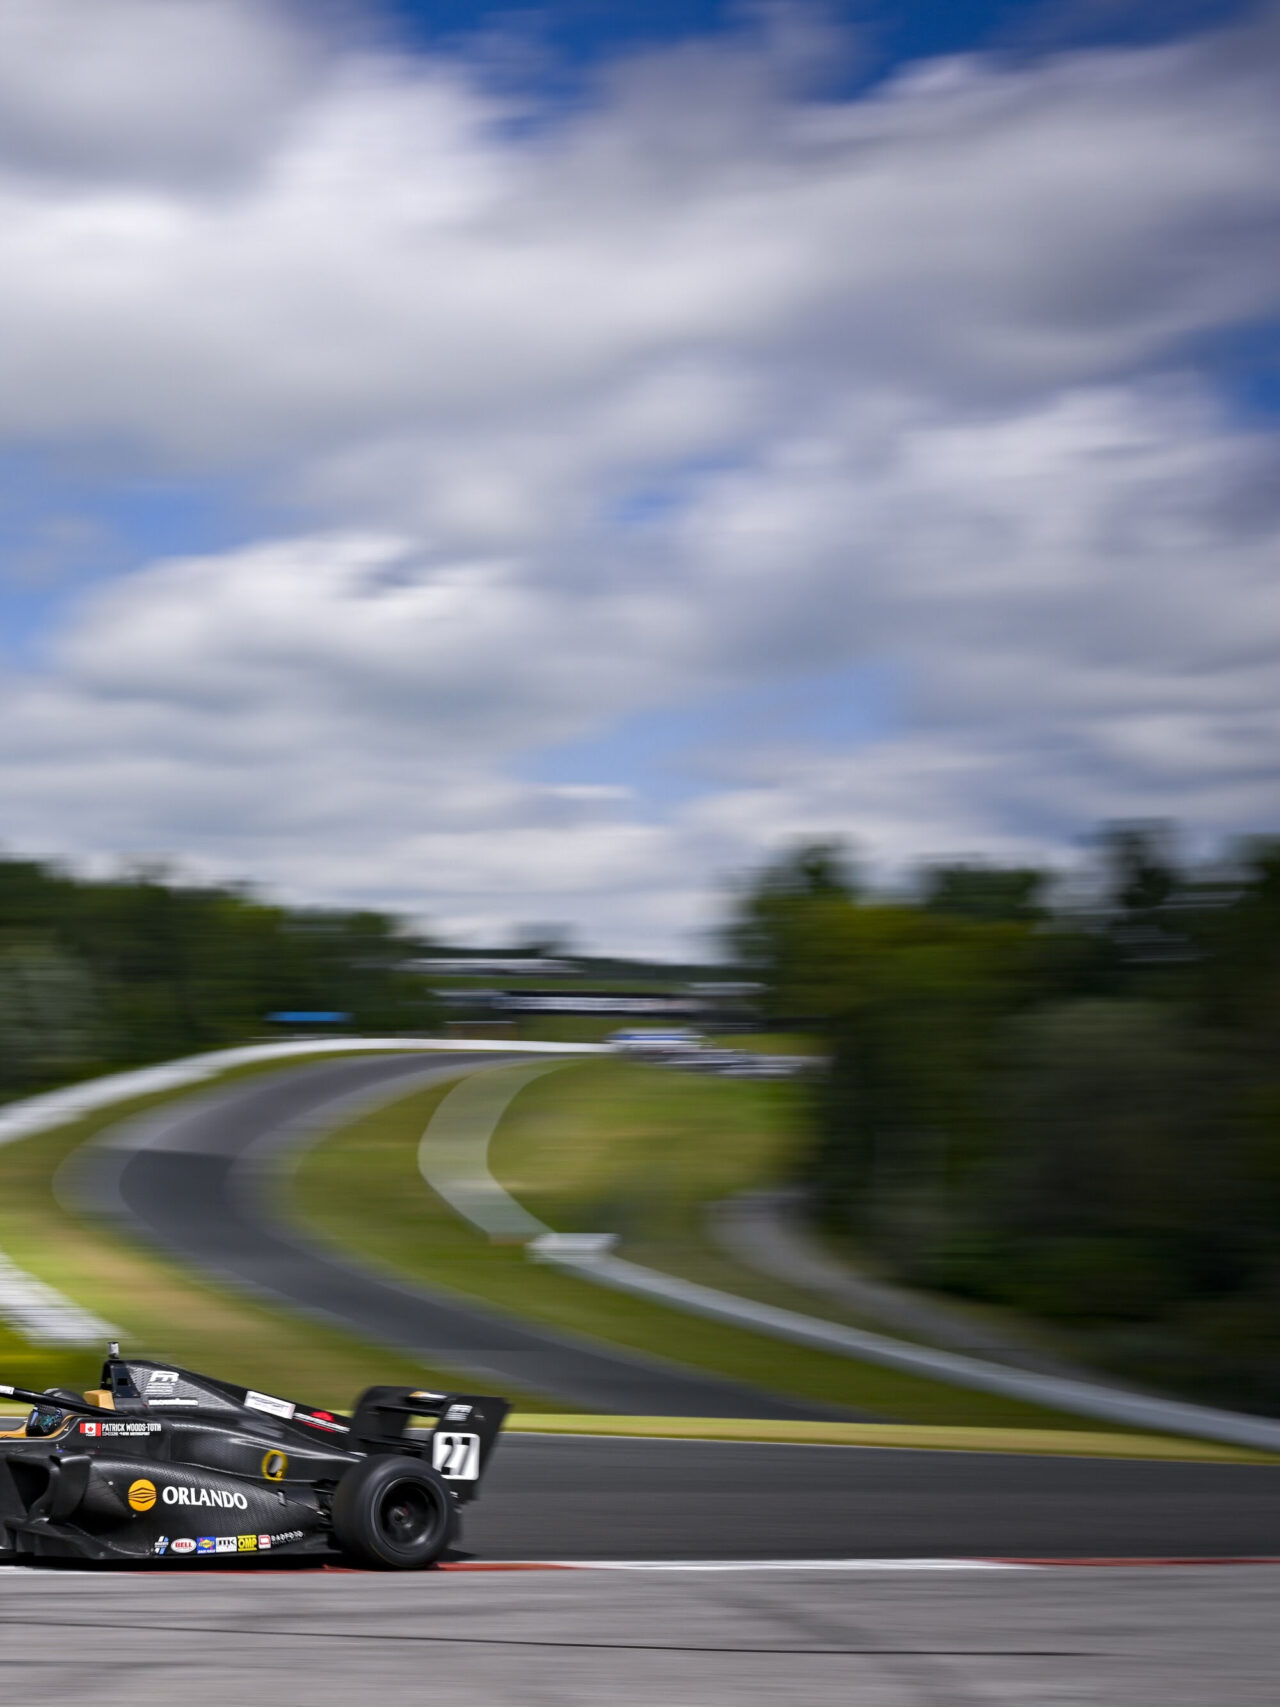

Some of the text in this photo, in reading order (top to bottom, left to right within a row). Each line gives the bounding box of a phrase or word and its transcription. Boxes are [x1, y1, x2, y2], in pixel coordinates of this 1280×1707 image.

[102, 1423, 125, 1431] PATRICK
[440, 1436, 472, 1475] 27
[162, 1486, 248, 1510] ORLANDO
[238, 1538, 257, 1548] OMP
